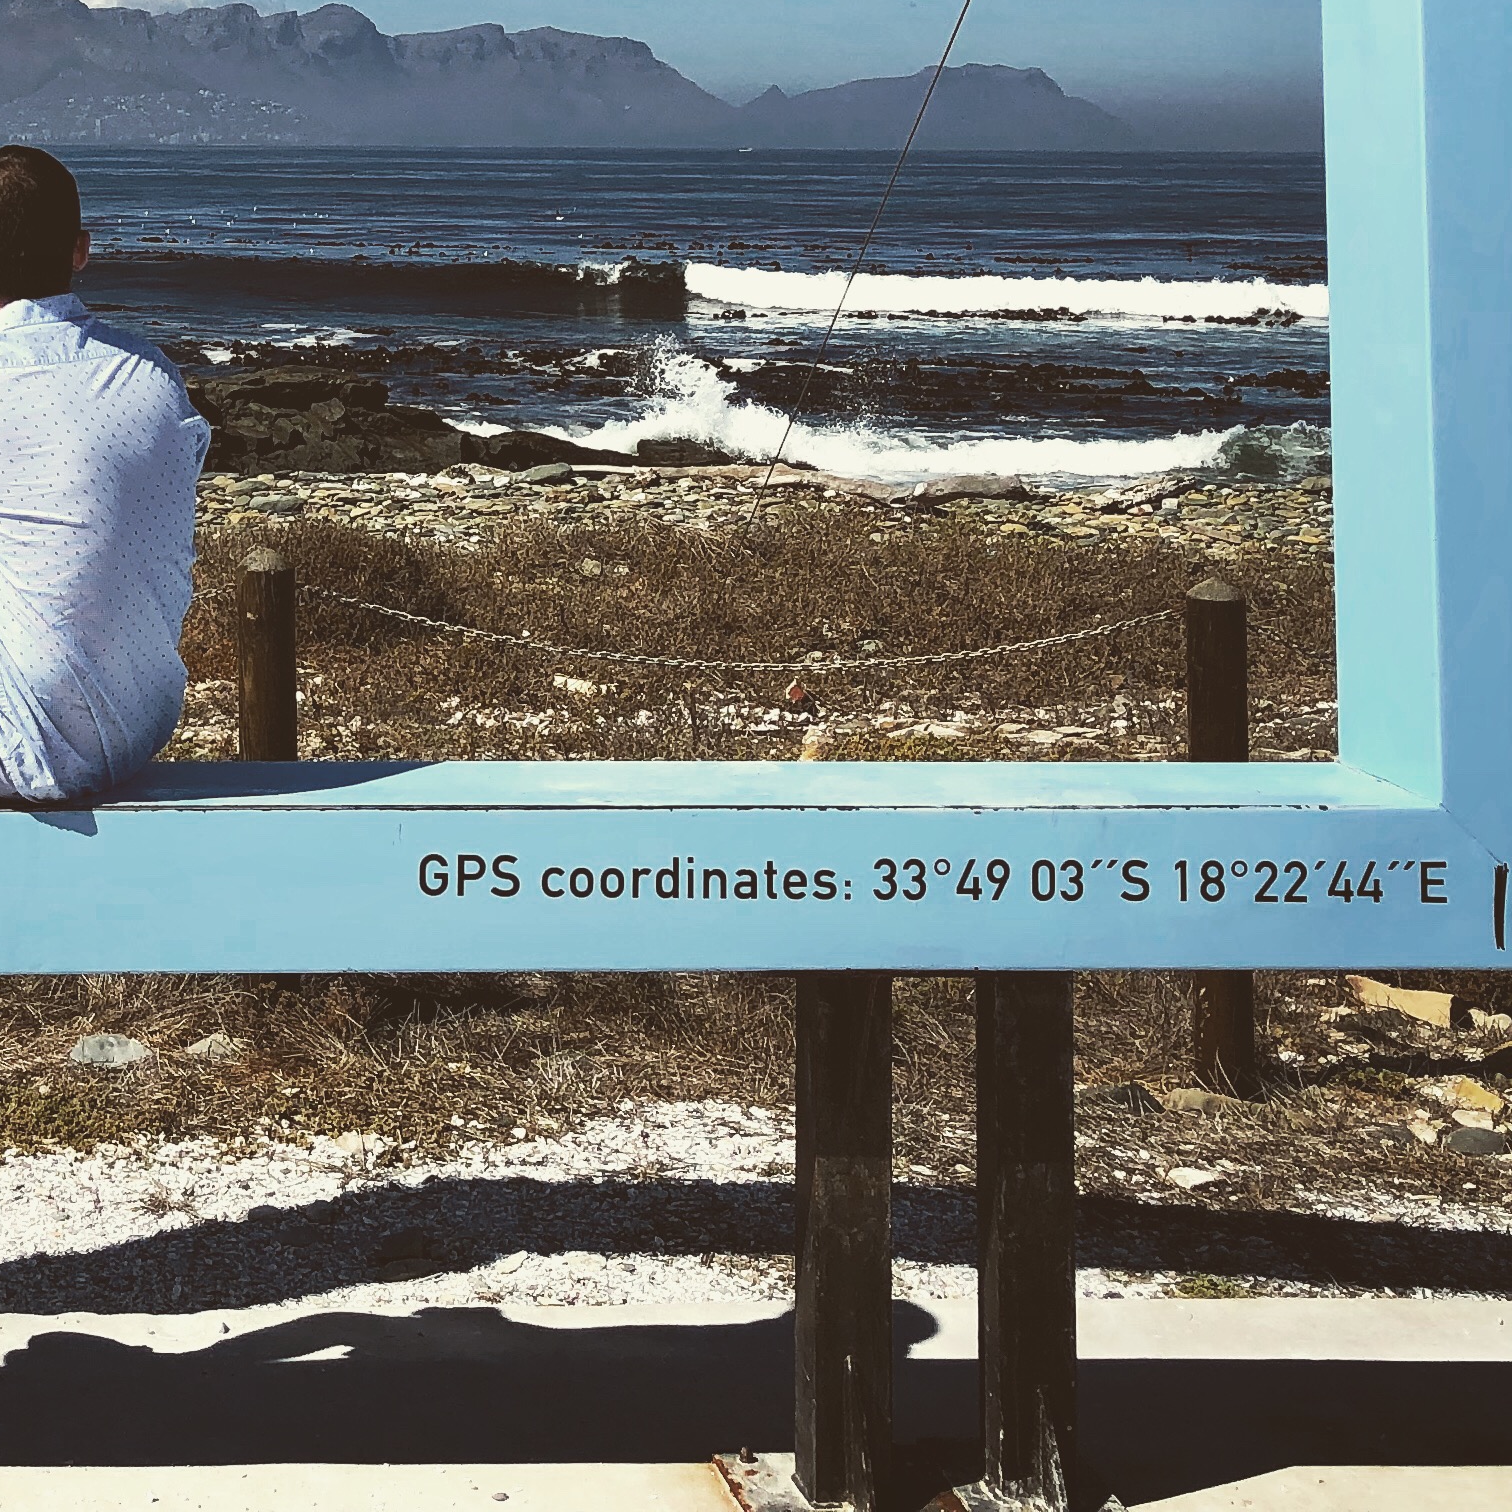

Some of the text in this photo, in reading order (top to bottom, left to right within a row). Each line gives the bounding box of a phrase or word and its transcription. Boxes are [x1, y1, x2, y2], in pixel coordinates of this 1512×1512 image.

[419, 853, 521, 898] GPS
[541, 856, 852, 901] coordinates:
[872, 858, 1011, 901] 33°49
